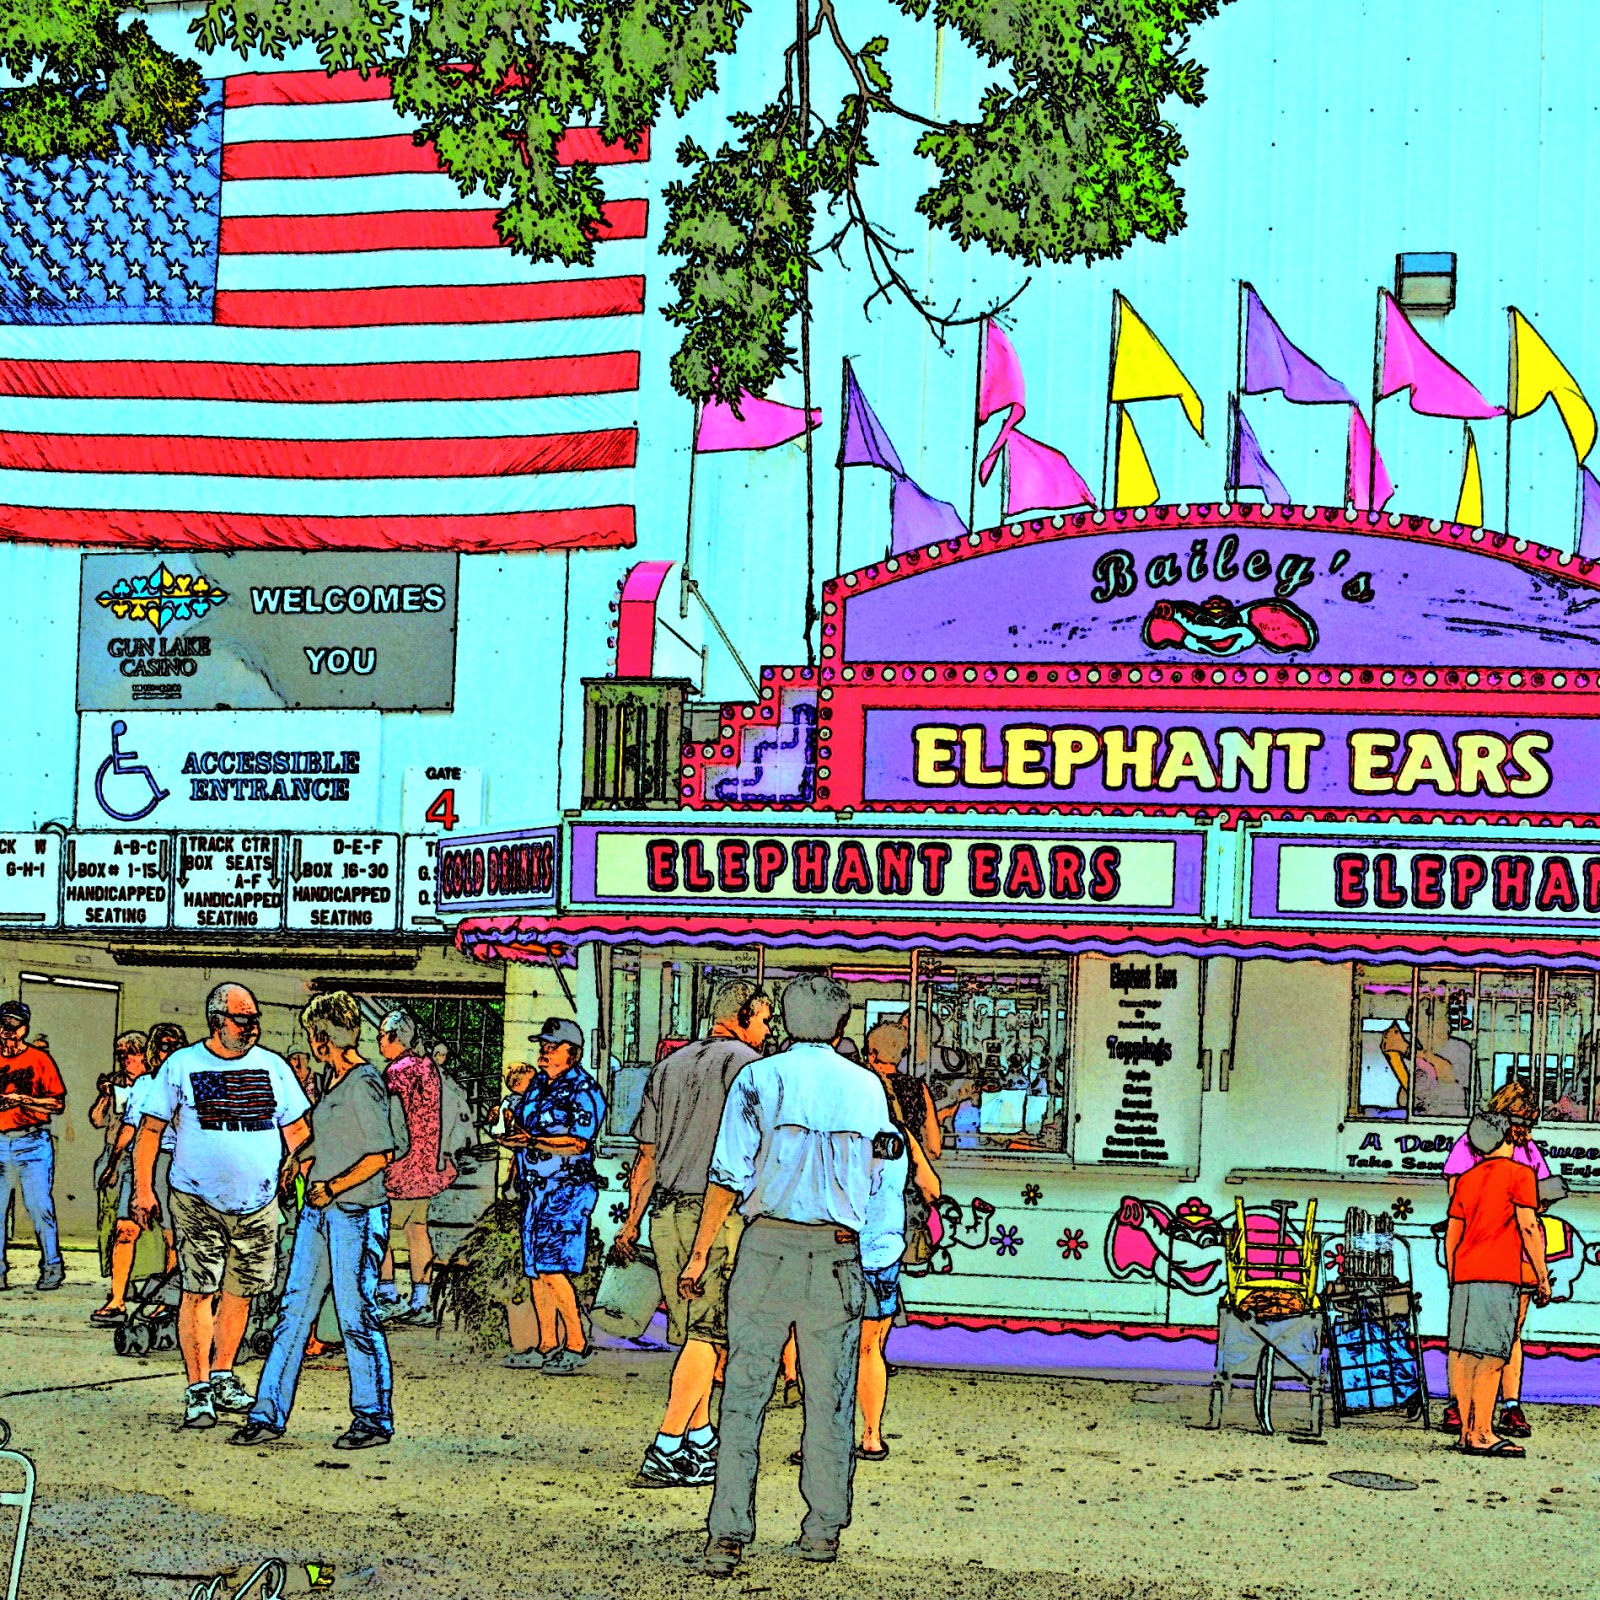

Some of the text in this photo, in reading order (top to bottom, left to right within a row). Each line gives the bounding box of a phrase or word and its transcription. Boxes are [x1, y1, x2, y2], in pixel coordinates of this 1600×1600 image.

[1091, 534, 1375, 602] Bailey's
[250, 584, 446, 614] WELCOMES
[107, 636, 212, 657] GUN LAKE
[119, 657, 198, 677] CASINO
[303, 646, 377, 675] YOU
[181, 751, 360, 774] ACCESSIBLE
[912, 723, 1553, 798] ELEPHANT EARS
[425, 766, 461, 781] GATE
[189, 778, 350, 801] ENTRANCE
[425, 788, 459, 831] 4
[35, 838, 47, 854] W
[113, 839, 157, 856] A-B-C
[189, 836, 271, 853] TRACK CTR
[333, 839, 383, 855] D-E-F
[6, 861, 45, 878] G-H-I
[184, 855, 272, 872] BOX SEATS
[302, 862, 389, 880] BOX 16-30
[443, 841, 554, 899] COLD DRINKS
[646, 839, 1122, 900] ELEPHANT EARS
[234, 873, 261, 889] A-F
[66, 885, 166, 902] HANDICAPPED
[184, 892, 282, 909] HANDICAPPED
[292, 886, 391, 903] HANDICAPPED
[85, 907, 147, 924] SEATING
[197, 910, 258, 927] SEATING
[310, 909, 373, 926] SEATING
[1359, 1132, 1383, 1151] A
[1394, 1134, 1455, 1153] Deli
[1346, 1154, 1393, 1168] Take
